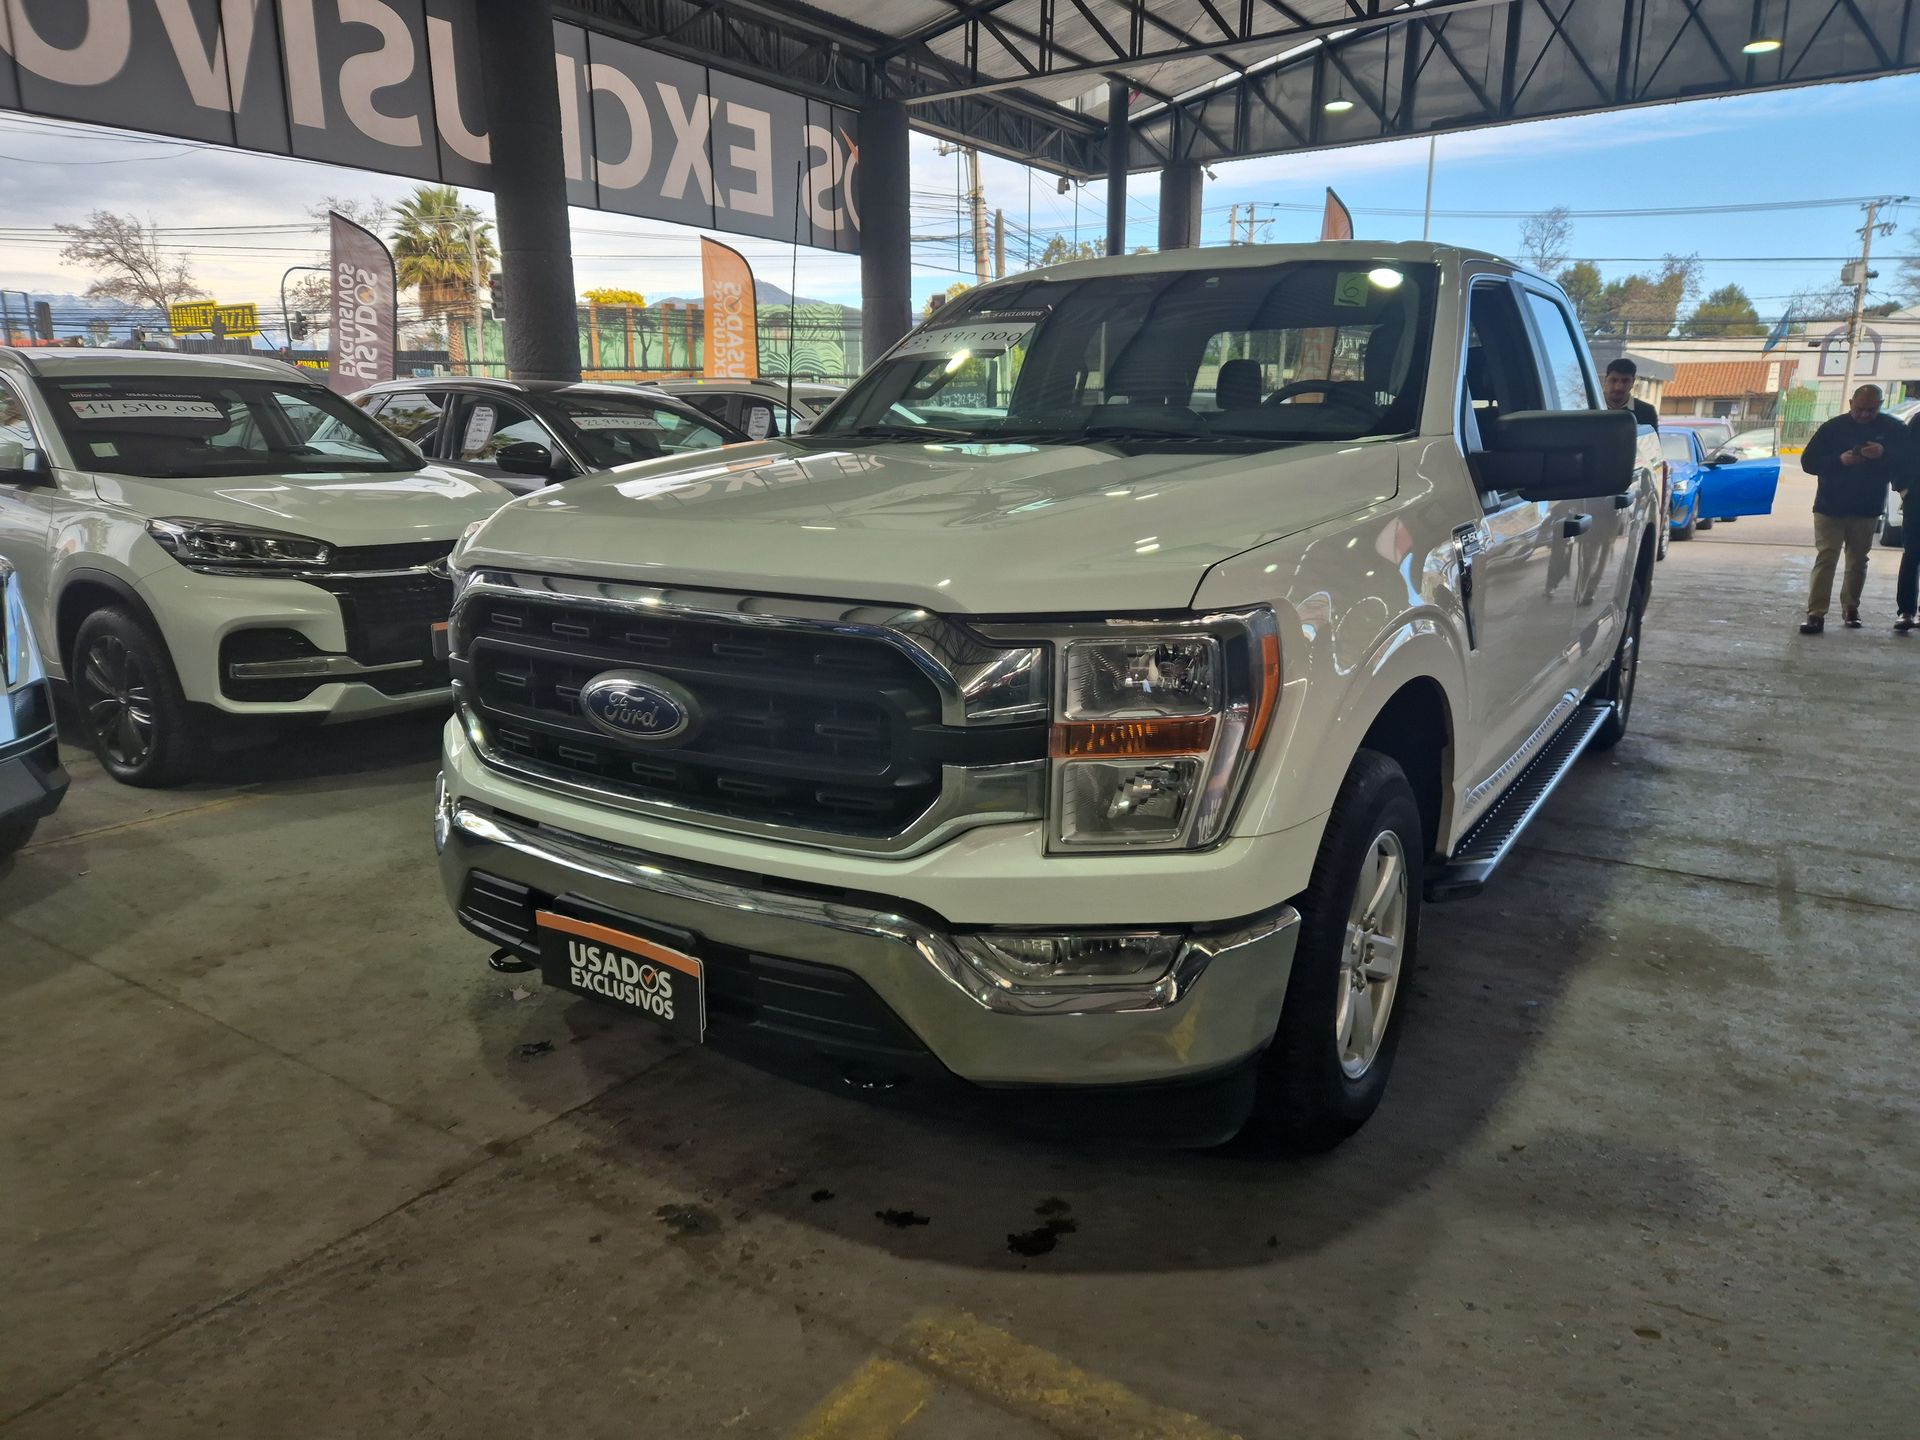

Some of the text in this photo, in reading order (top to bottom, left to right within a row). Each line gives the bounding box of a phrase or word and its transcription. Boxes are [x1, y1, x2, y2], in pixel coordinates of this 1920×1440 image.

[604, 692, 659, 728] Ford
[568, 941, 673, 999] USADOS
[570, 966, 675, 1021] EXCLUSIVOS
